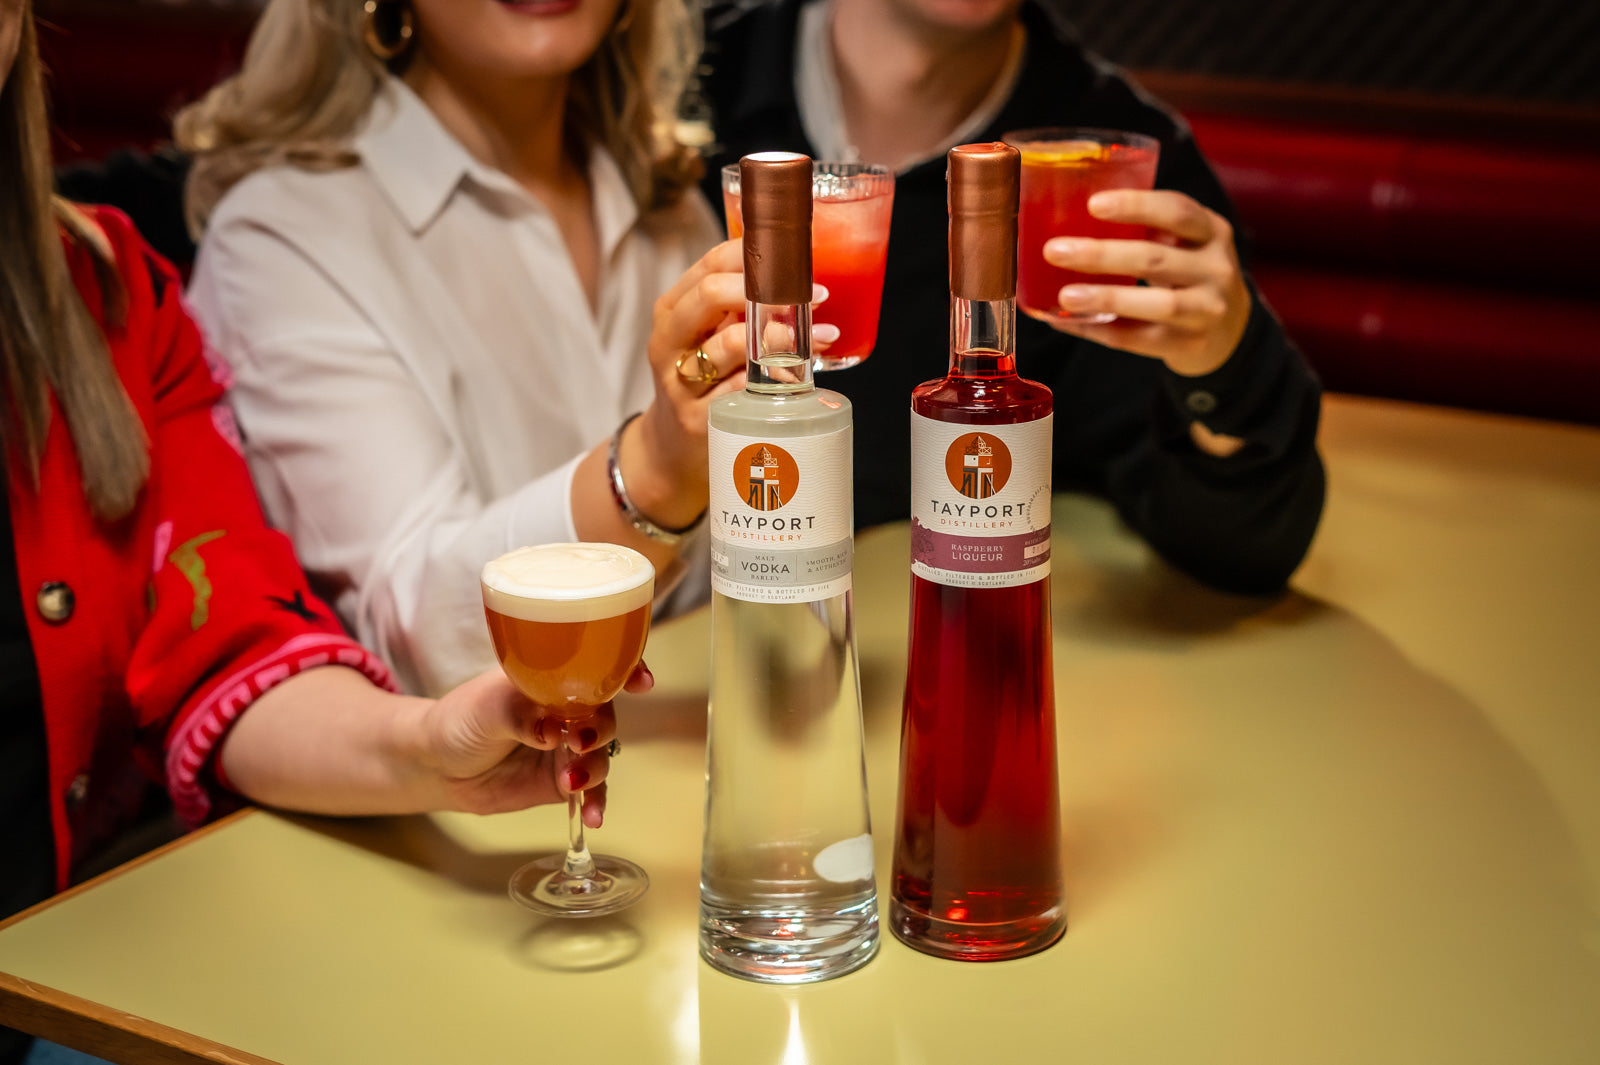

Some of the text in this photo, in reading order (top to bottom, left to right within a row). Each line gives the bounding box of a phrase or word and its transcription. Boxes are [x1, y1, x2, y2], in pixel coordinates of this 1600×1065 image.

[931, 500, 1025, 518] TAYPORT
[722, 511, 816, 530] TAYPORT
[941, 518, 1013, 529] DISTILLERY
[730, 530, 802, 542] DISTILLERY
[951, 544, 1004, 552] RASPBERRY
[952, 552, 1003, 562] LIQUEUR
[741, 561, 790, 574] VODKA
